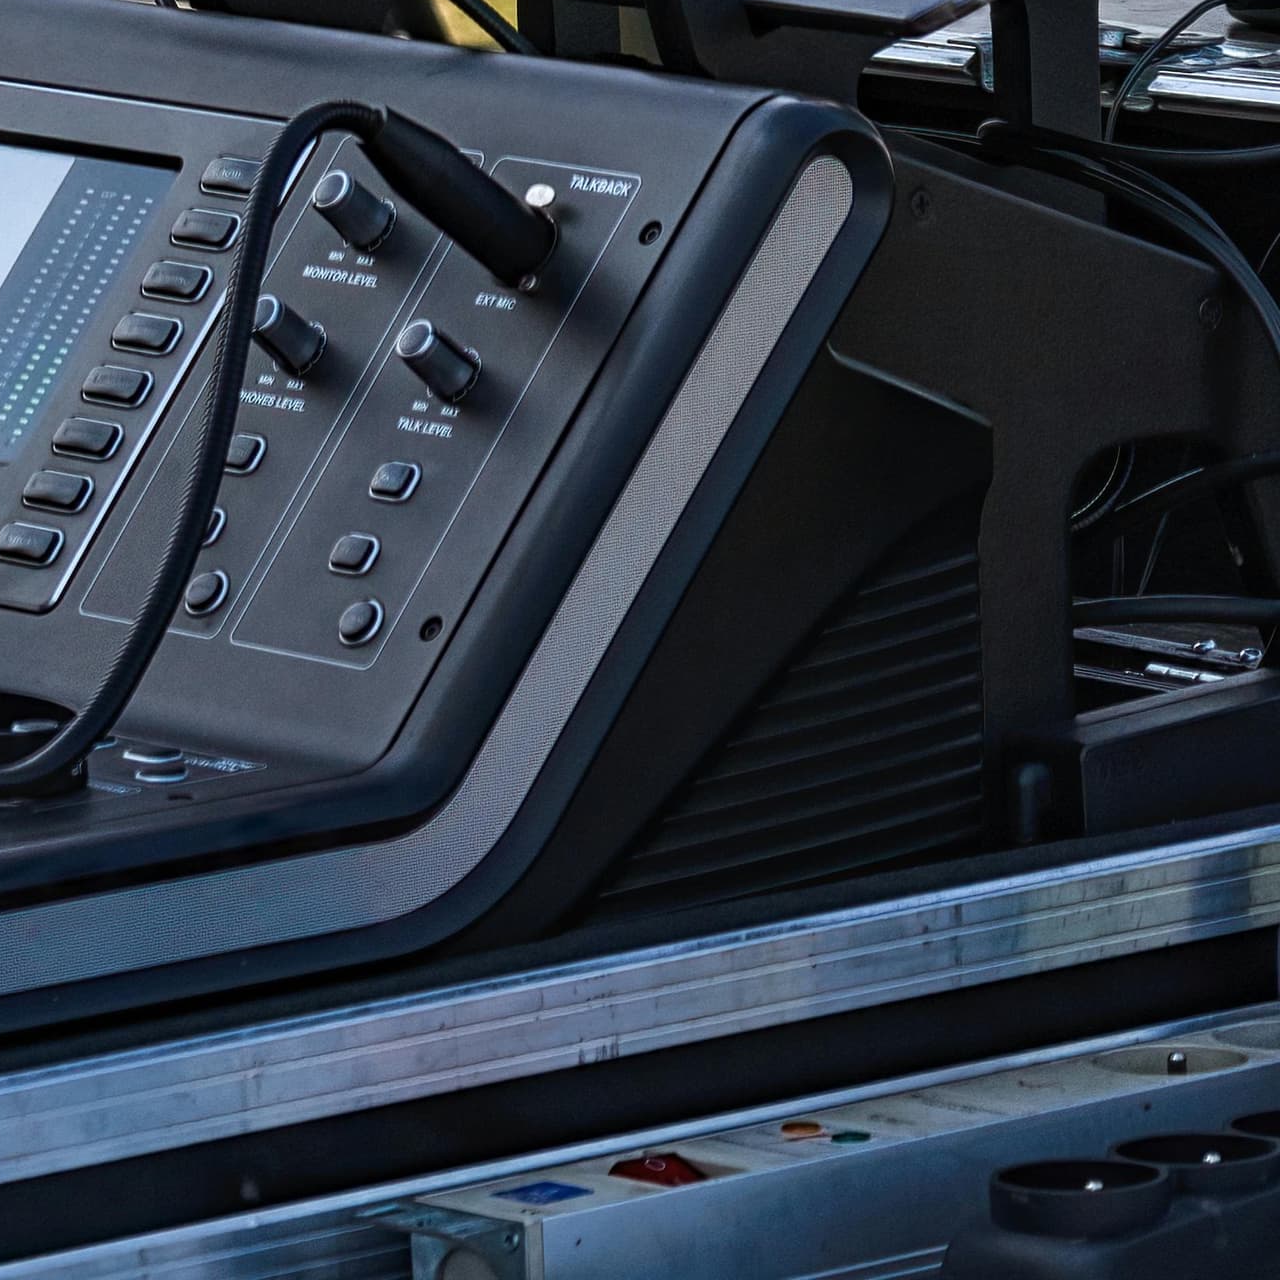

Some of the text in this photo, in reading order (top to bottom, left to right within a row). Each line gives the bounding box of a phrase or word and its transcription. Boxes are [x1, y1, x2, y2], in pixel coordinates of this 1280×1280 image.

[569, 173, 633, 197] TALKBACK
[327, 250, 376, 267] MIN MAX
[302, 264, 379, 289] MONITOR LEVEL
[475, 291, 518, 311] EXT MIC
[285, 378, 306, 391] MAX
[274, 395, 306, 413] LEVEL
[440, 405, 461, 418] MAX
[397, 415, 454, 439] TALK LEVEL
